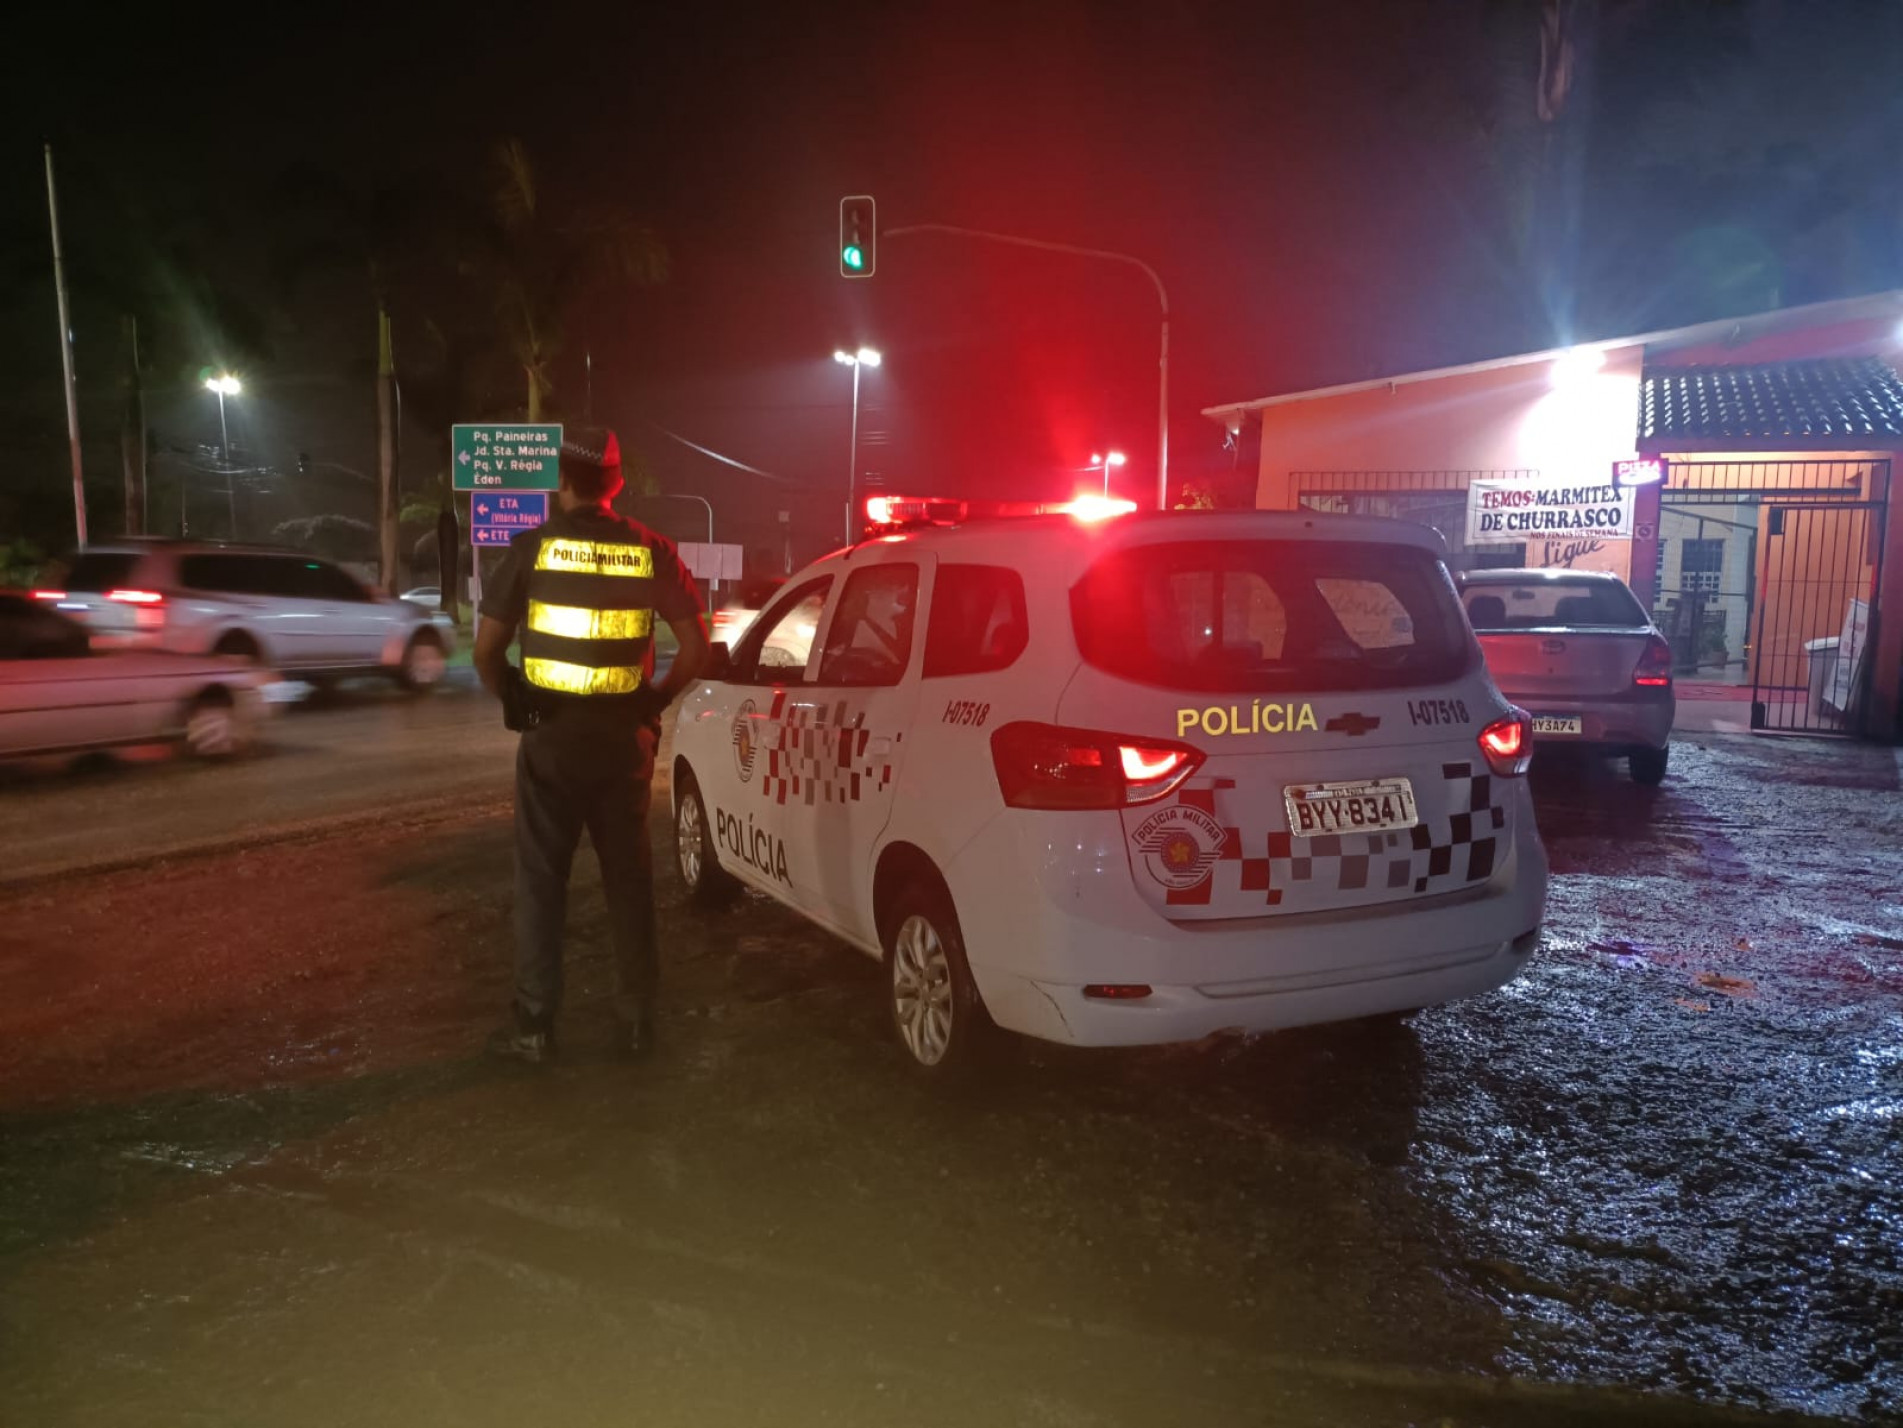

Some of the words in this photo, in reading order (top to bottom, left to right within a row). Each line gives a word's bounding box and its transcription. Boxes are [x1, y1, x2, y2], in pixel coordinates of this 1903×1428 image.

[473, 431, 492, 444] Pq.
[495, 431, 548, 442] Paineiras
[474, 446, 490, 456] Jd.
[493, 446, 515, 456] Sta.
[518, 446, 558, 456] Marina
[473, 460, 492, 472] Pq.
[495, 460, 507, 470] V.
[510, 459, 543, 472] Régia
[474, 473, 502, 484] Éden
[1535, 484, 1622, 507] MARMITEX
[500, 498, 519, 509] ETA
[1480, 512, 1503, 531] DE
[1507, 507, 1622, 530] CHURRASCO
[491, 530, 510, 540] ETE
[597, 553, 641, 567] MILITAR
[1177, 698, 1318, 737] POLÍCIA
[1532, 718, 1575, 732] HY3A74
[1183, 810, 1220, 841] MILITAR
[716, 807, 794, 889] POLÍCIA
